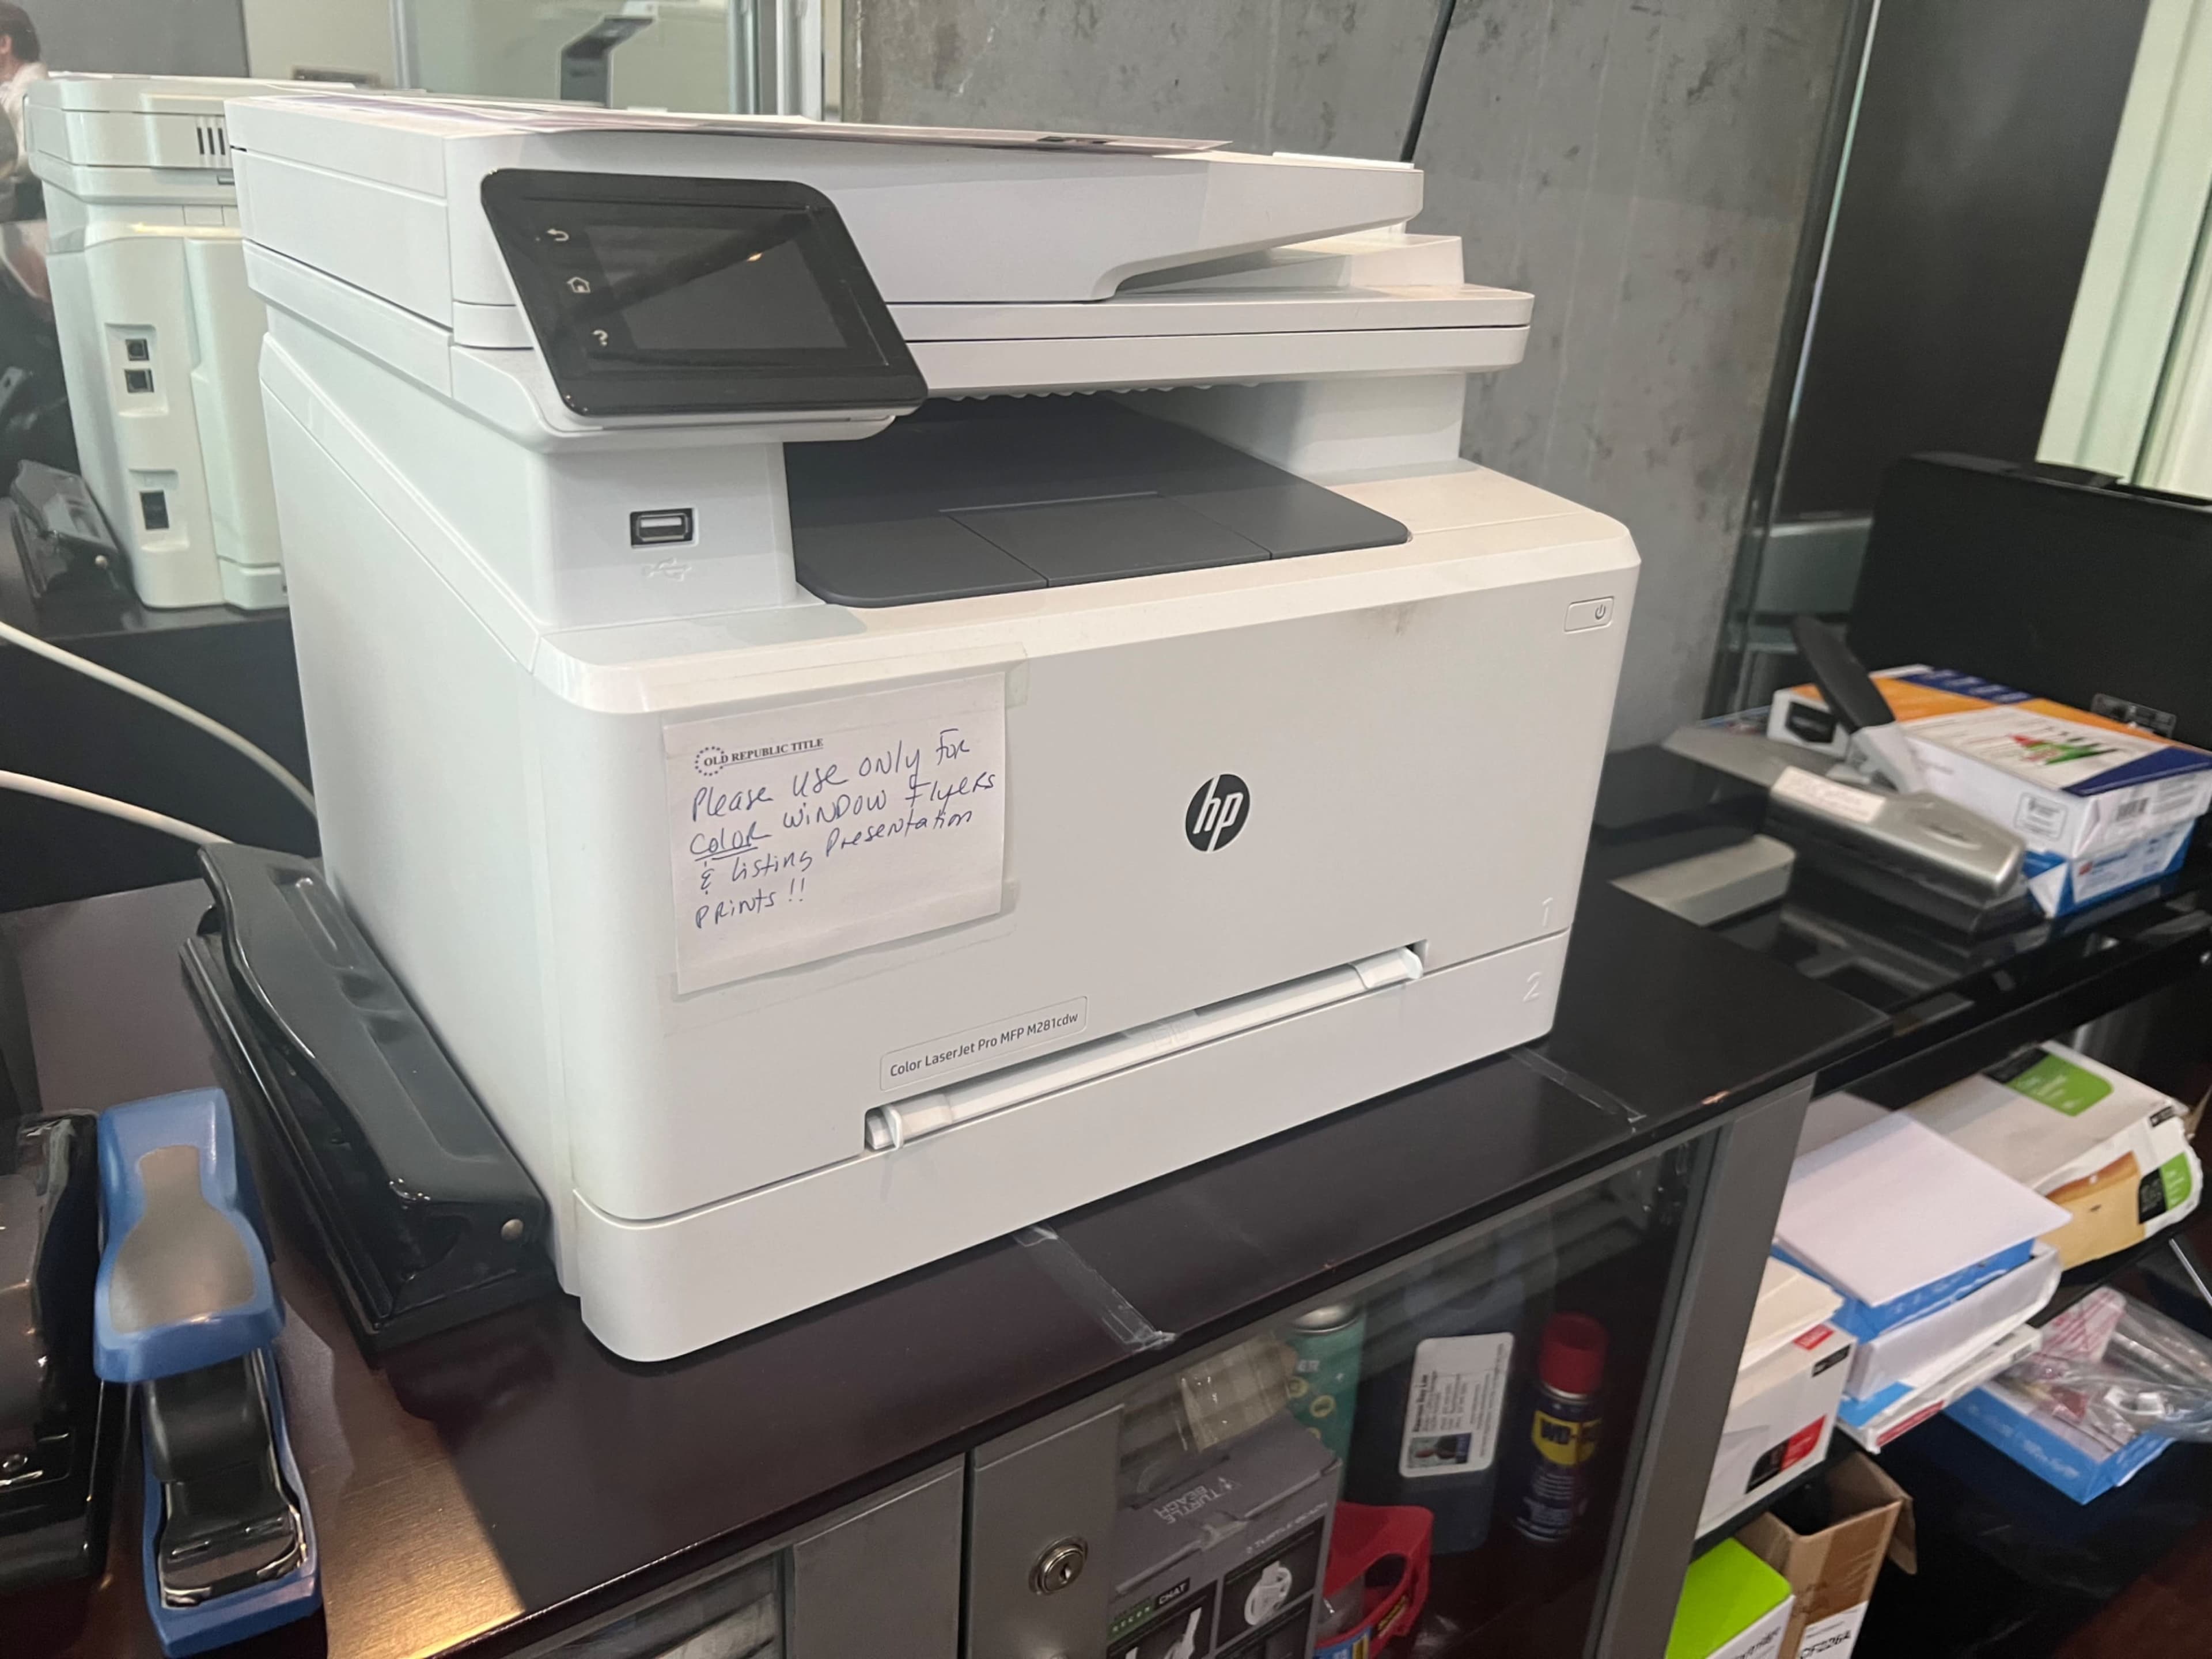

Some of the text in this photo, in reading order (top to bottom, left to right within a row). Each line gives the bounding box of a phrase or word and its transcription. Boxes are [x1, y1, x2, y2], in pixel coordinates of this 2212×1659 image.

[703, 738, 824, 767] OLD REPUBLIC TITLE
[1187, 774, 1249, 853] hp
[700, 861, 714, 895] &
[889, 1012, 1079, 1077] Color LaserJet Pro MFP M281cdw
